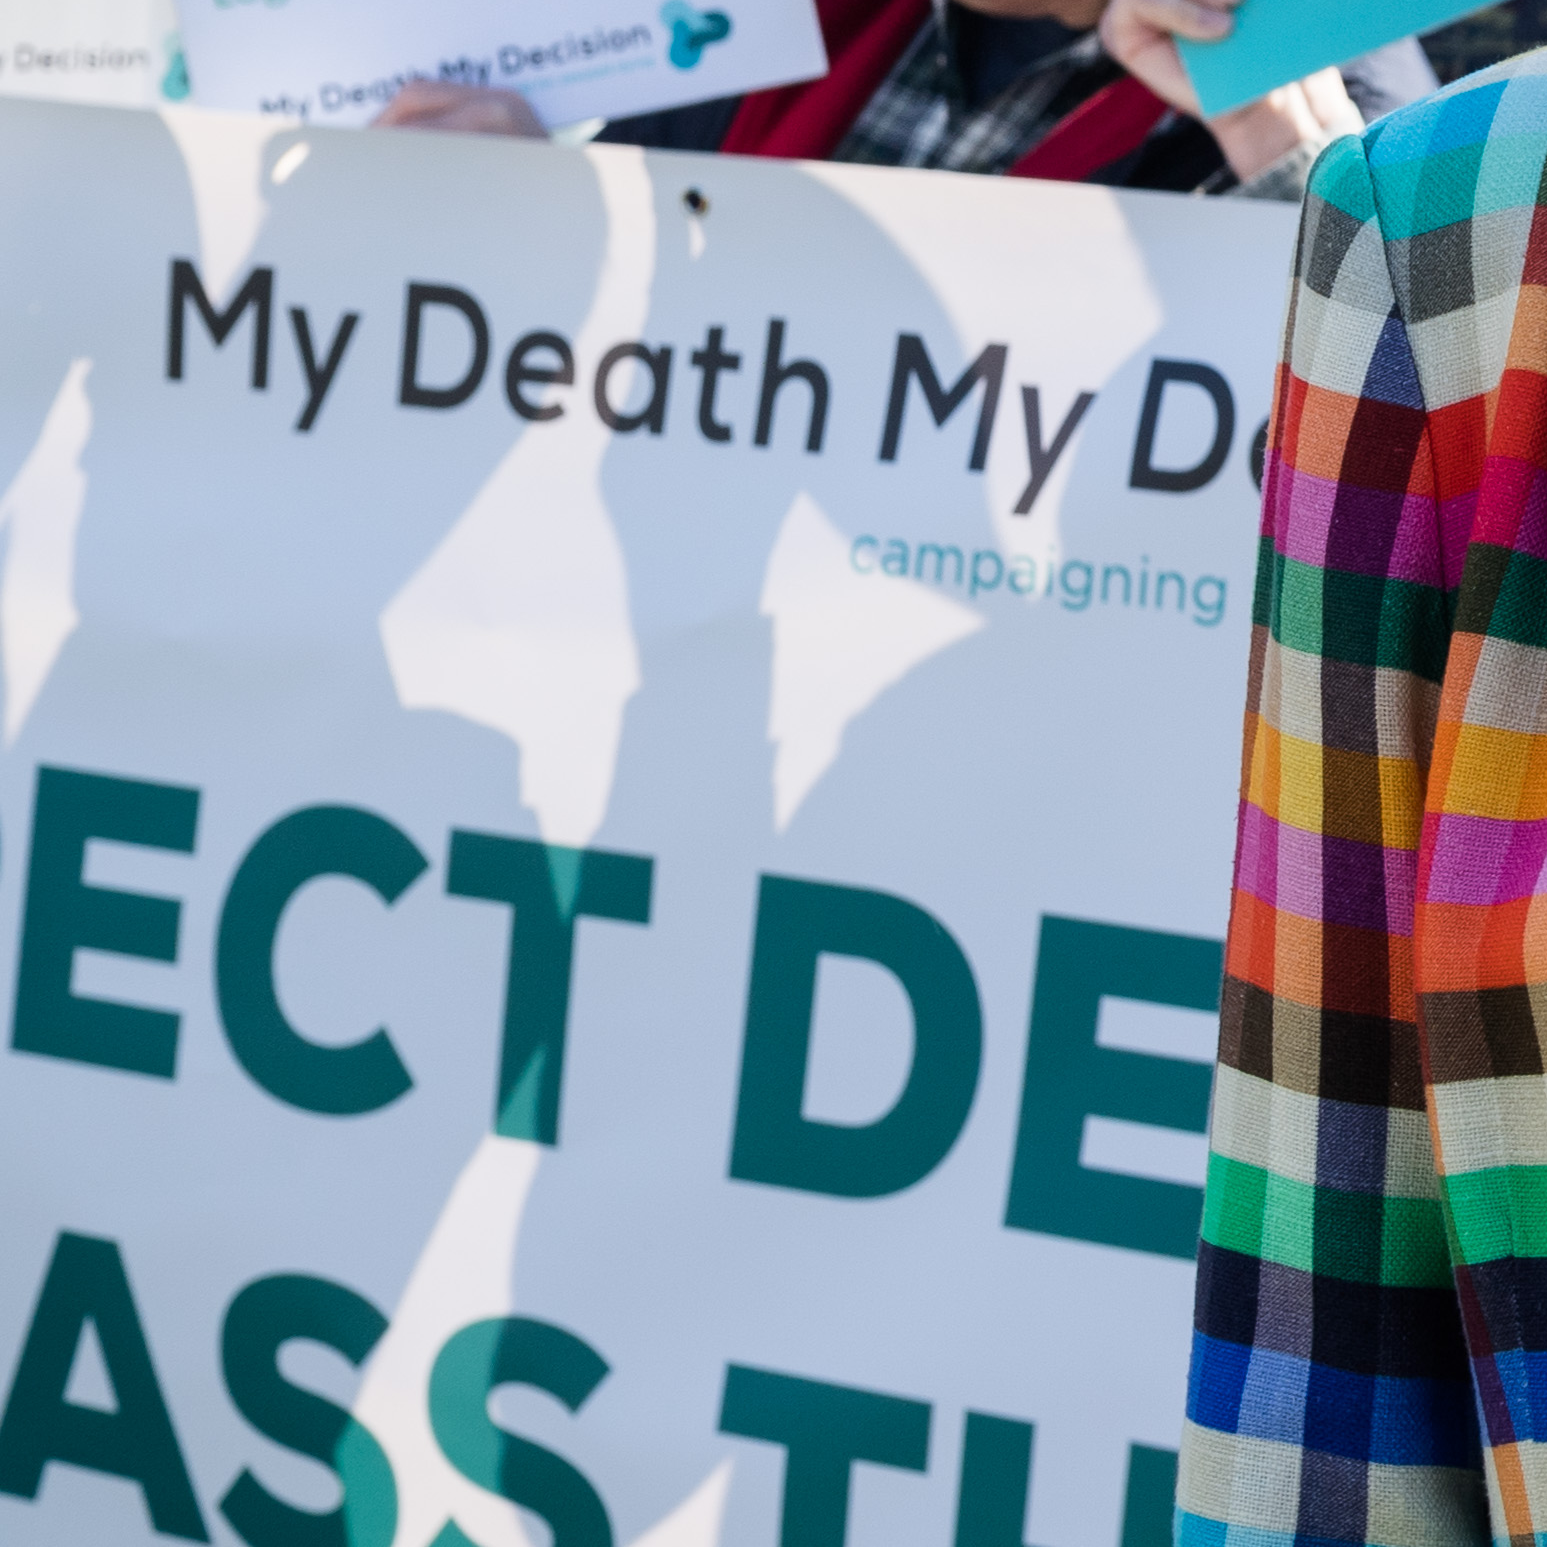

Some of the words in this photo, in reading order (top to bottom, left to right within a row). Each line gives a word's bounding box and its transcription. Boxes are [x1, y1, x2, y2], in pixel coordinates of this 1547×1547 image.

[498, 25, 653, 77] Decision
[166, 256, 363, 433] My
[396, 278, 831, 455] Death
[877, 330, 1098, 517] My
[850, 533, 1229, 628] campaigning
[0, 762, 656, 1150] ECT
[727, 872, 1226, 1264] DE
